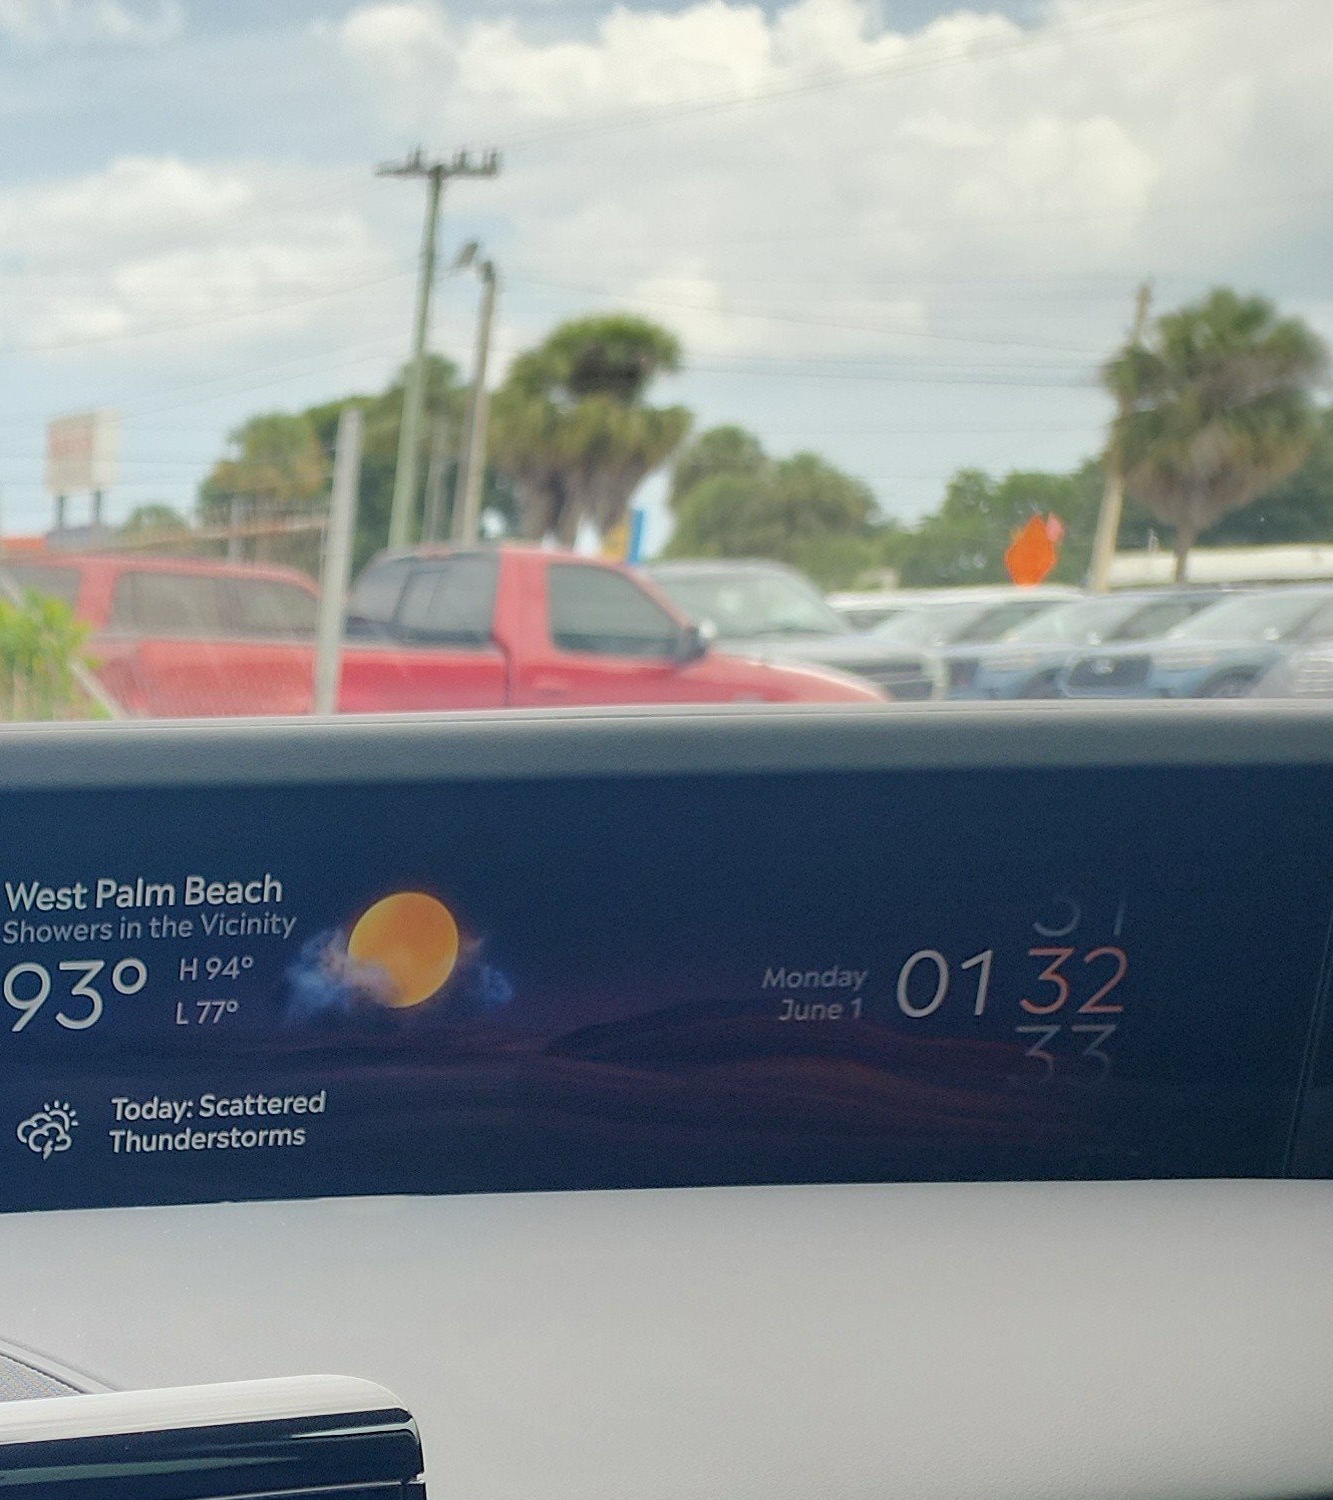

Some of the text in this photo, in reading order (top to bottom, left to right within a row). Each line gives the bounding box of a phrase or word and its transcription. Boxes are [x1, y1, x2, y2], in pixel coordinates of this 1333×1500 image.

[4, 874, 283, 912] West Palm Beach
[2, 912, 297, 945] Showers in the Vicinity
[179, 957, 199, 981] H
[761, 967, 868, 992] Monday
[895, 945, 1129, 1019] 01 32
[175, 1002, 190, 1026] L
[777, 997, 863, 1023] June 1
[111, 1091, 326, 1126] Today: Scattered
[108, 1125, 307, 1154] Thunderstorms
